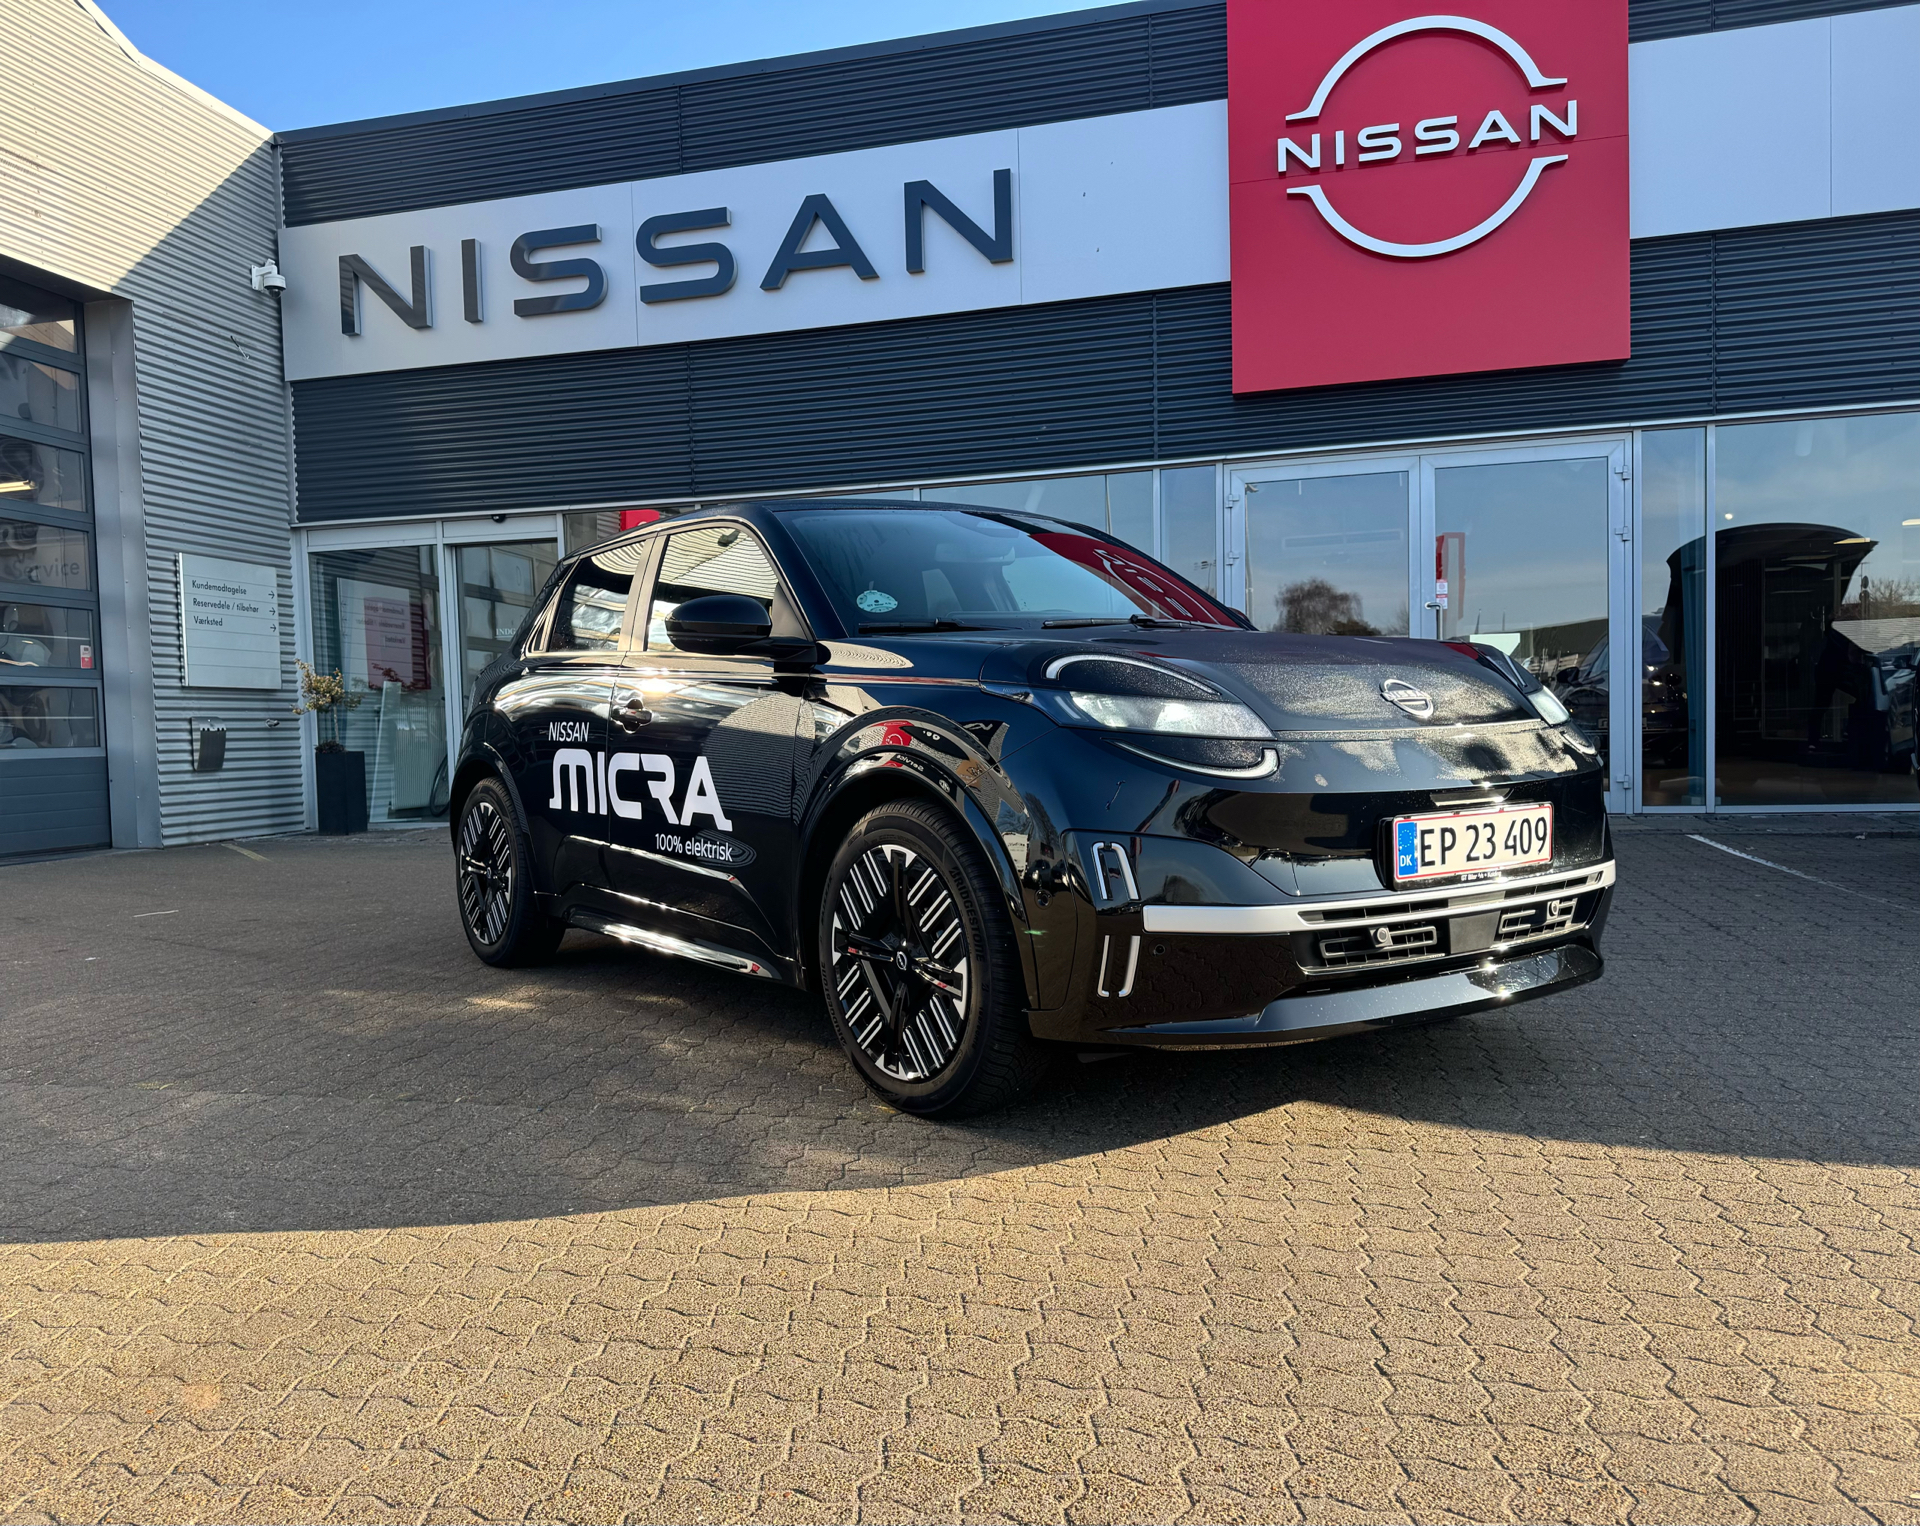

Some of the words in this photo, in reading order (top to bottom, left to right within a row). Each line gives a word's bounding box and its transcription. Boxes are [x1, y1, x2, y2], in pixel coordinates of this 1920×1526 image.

[1277, 100, 1577, 172] NISSAN
[338, 168, 1014, 336] NISSAN
[192, 580, 247, 595] Kundemodtagelse
[193, 598, 231, 610] Reservedele
[194, 616, 223, 626] Værksted
[548, 721, 590, 742] NISSAN
[549, 748, 733, 832] MICRA
[655, 833, 683, 854] 100%
[684, 837, 733, 862] elektrisk
[1420, 827, 1457, 867] EP
[1466, 822, 1497, 863] 23
[1504, 816, 1548, 856] 409
[1400, 855, 1412, 867] DK
[949, 866, 985, 963] BRIDGESTONE
